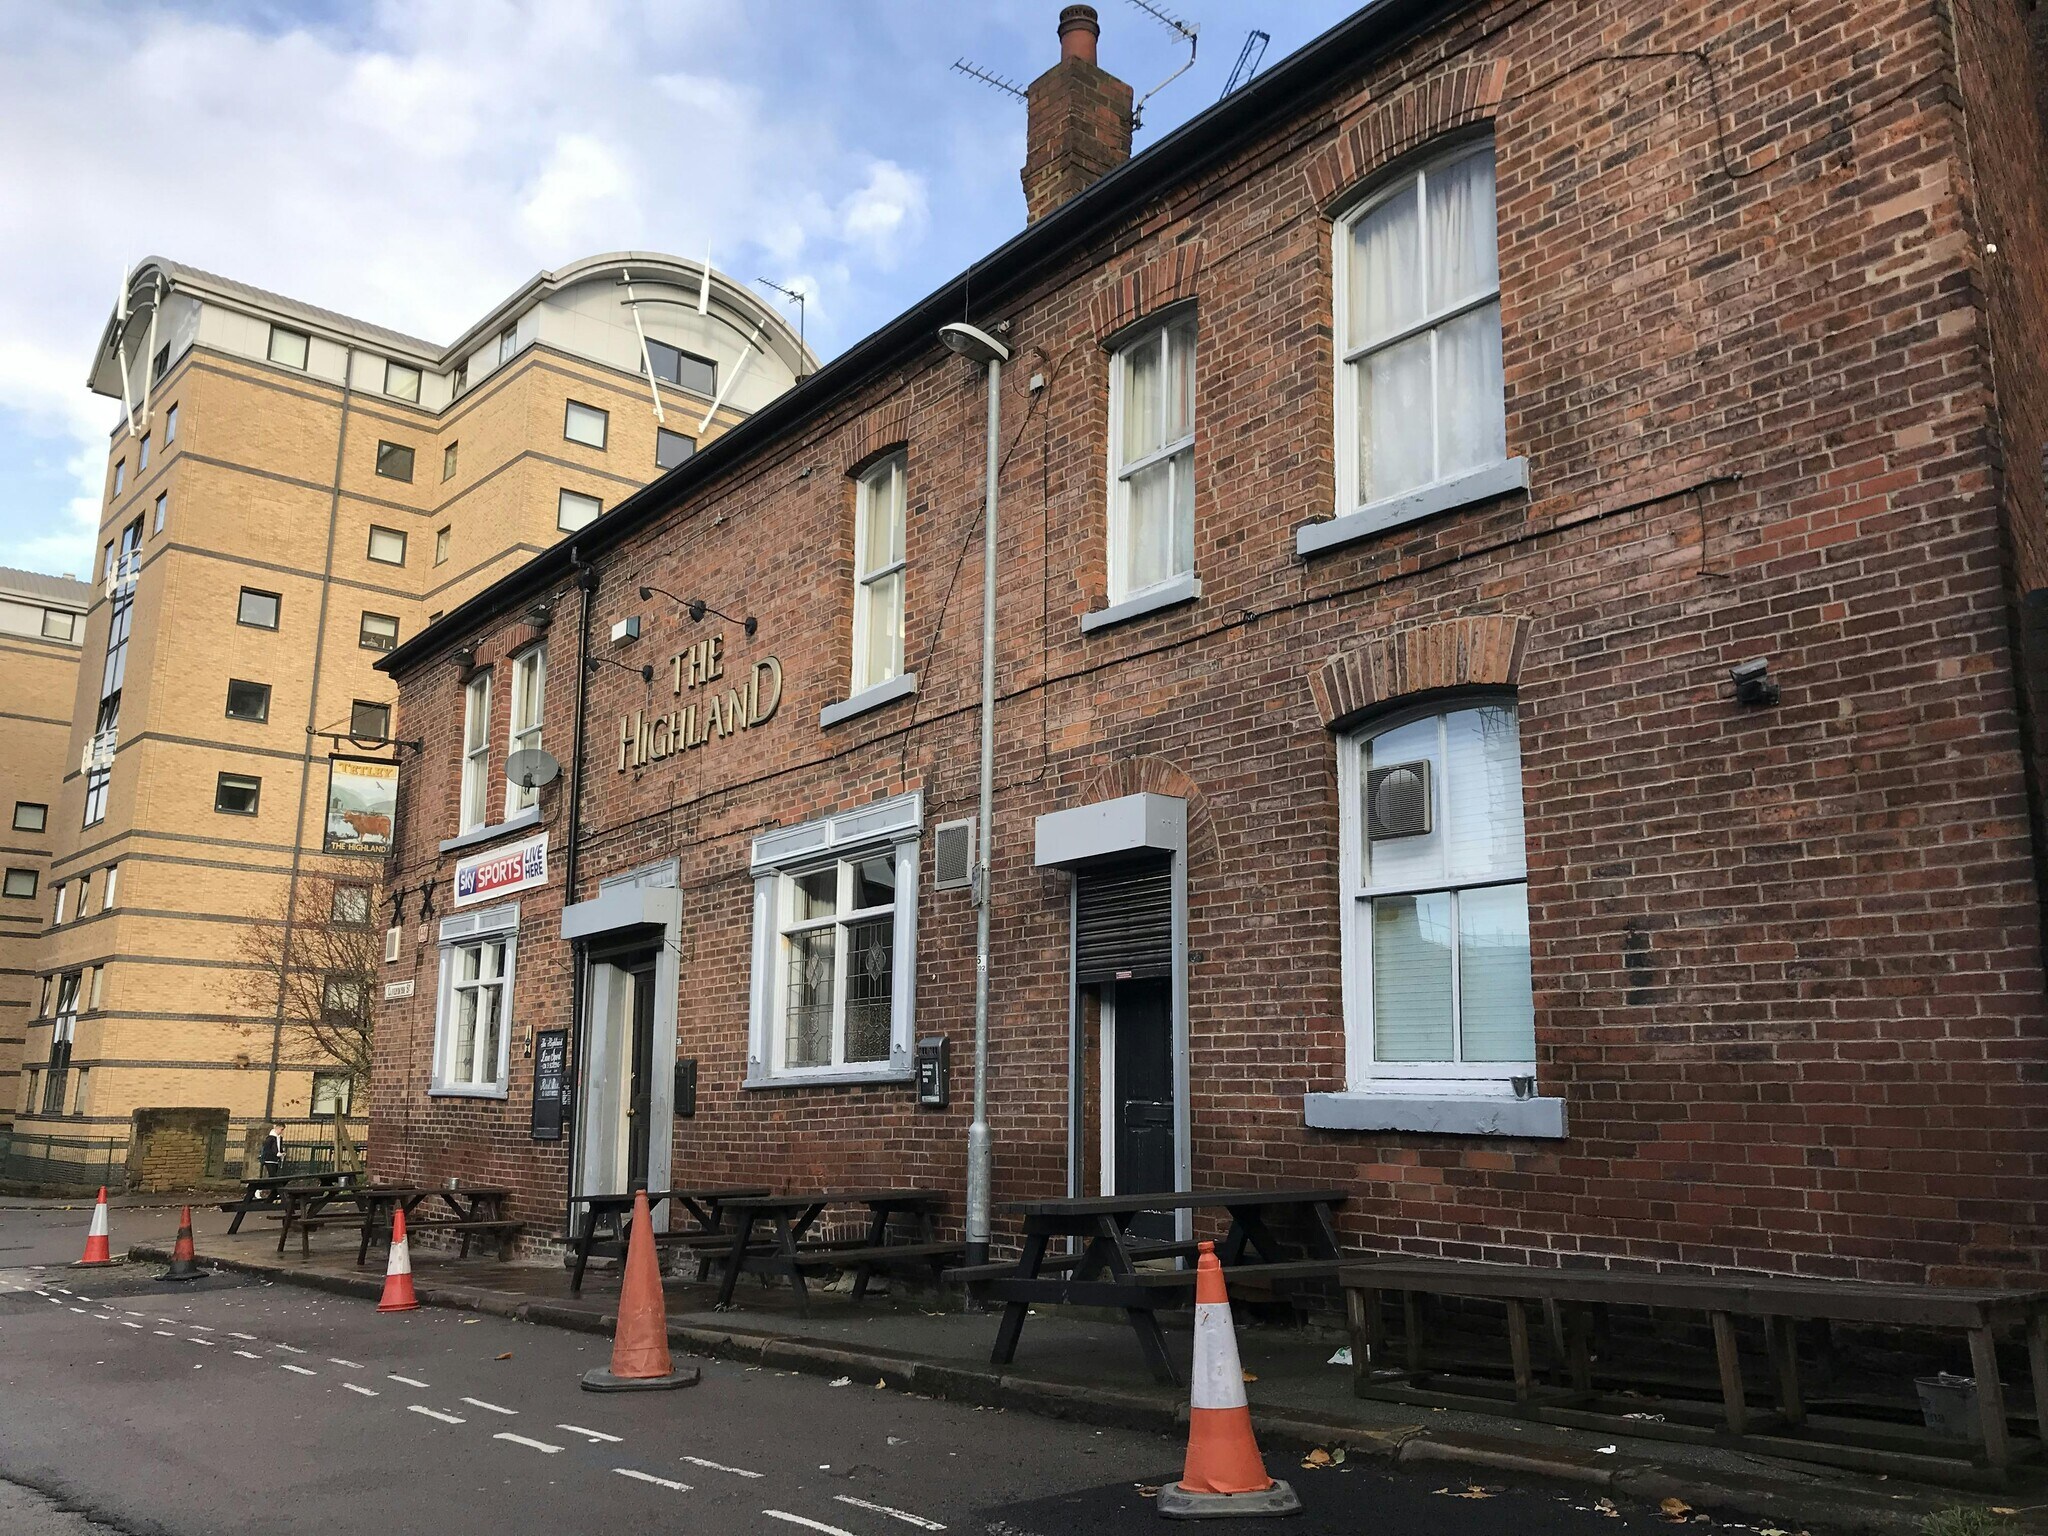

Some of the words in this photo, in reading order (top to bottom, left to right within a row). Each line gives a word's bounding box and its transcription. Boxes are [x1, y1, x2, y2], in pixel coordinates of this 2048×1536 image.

[670, 632, 724, 696] THE
[618, 656, 783, 774] HIGHLAND
[338, 762, 394, 778] TETLEY
[331, 841, 346, 850] THE
[348, 843, 387, 853] HIGHLAND
[525, 844, 544, 864] LIVE
[460, 869, 476, 893] sky
[478, 856, 521, 888] SPORTS
[525, 861, 544, 879] HERE
